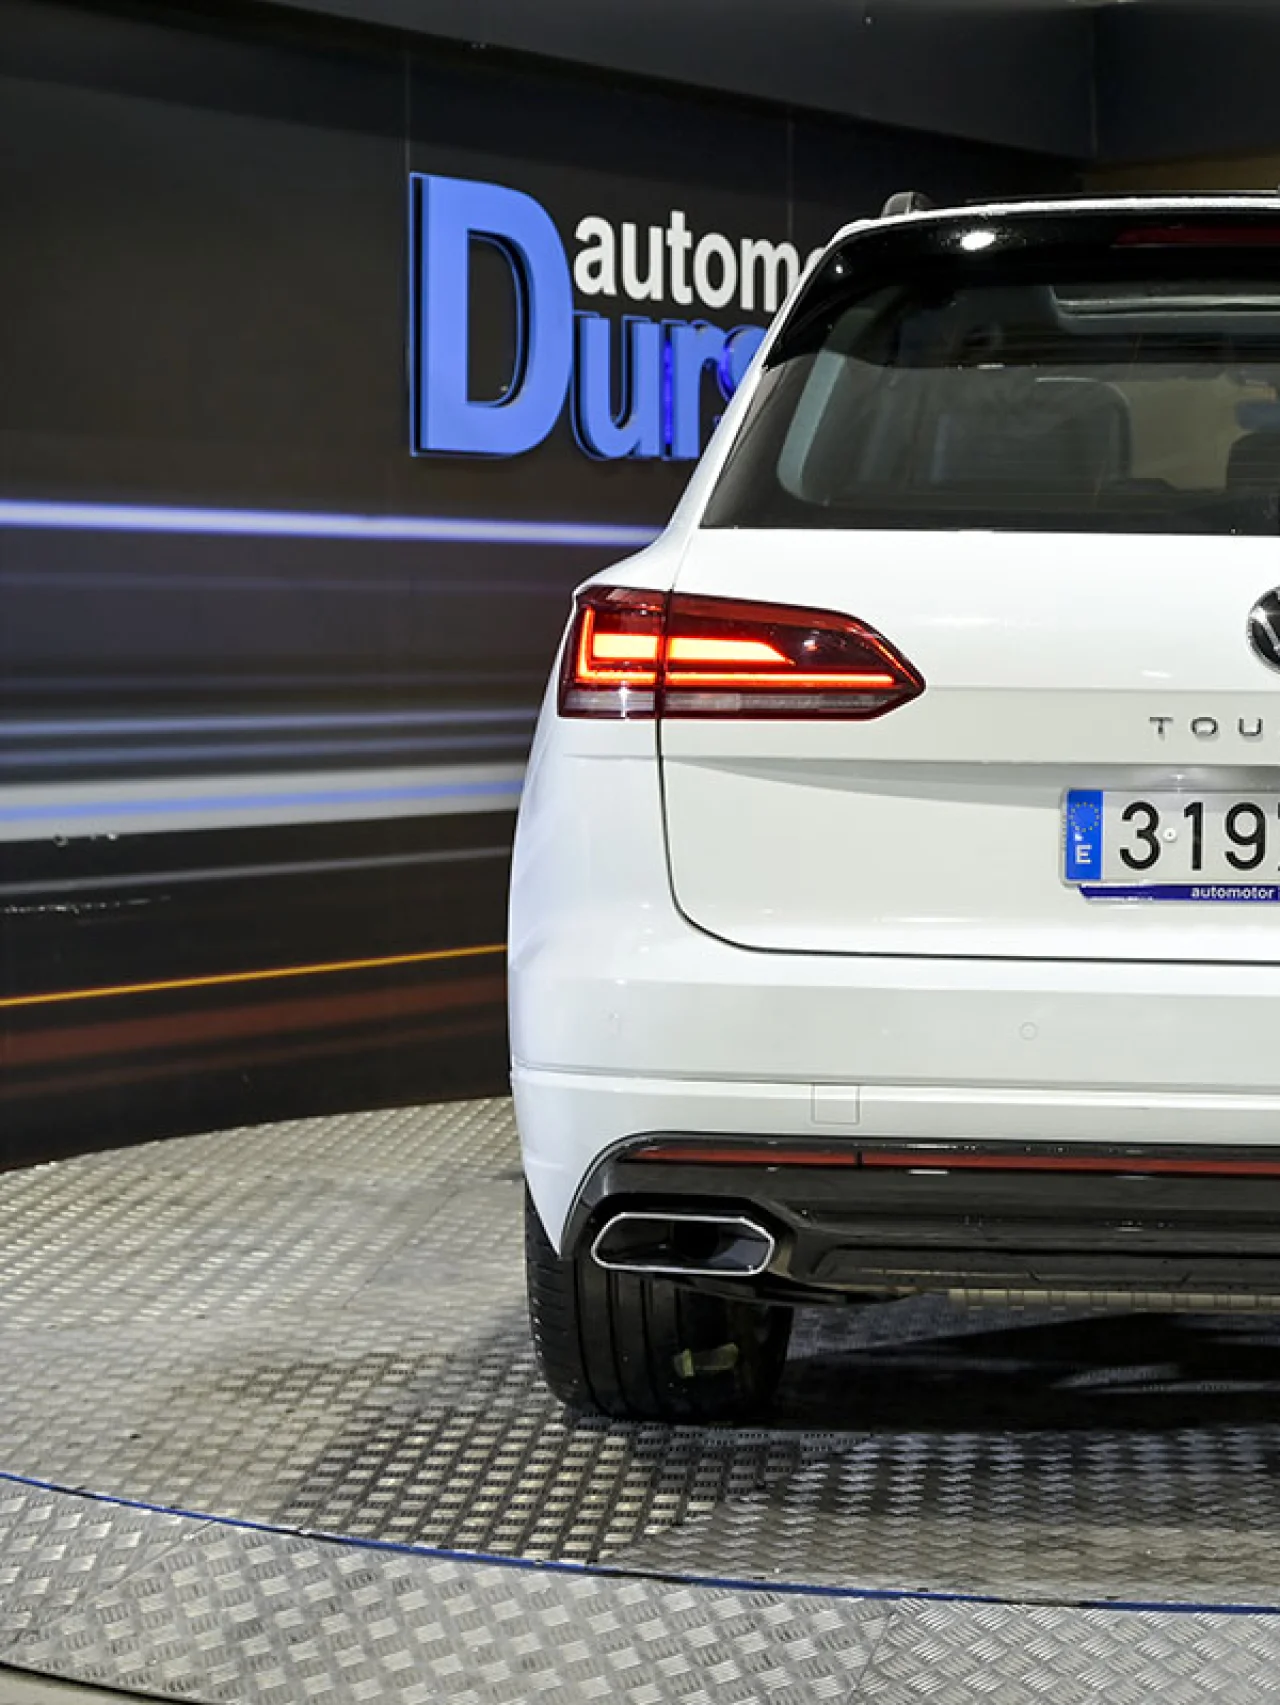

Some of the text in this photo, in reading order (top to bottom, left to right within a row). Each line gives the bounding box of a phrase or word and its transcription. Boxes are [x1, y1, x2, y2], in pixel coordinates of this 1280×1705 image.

[574, 210, 828, 313] autom
[1075, 844, 1093, 864] E
[1191, 886, 1275, 900] automotor
